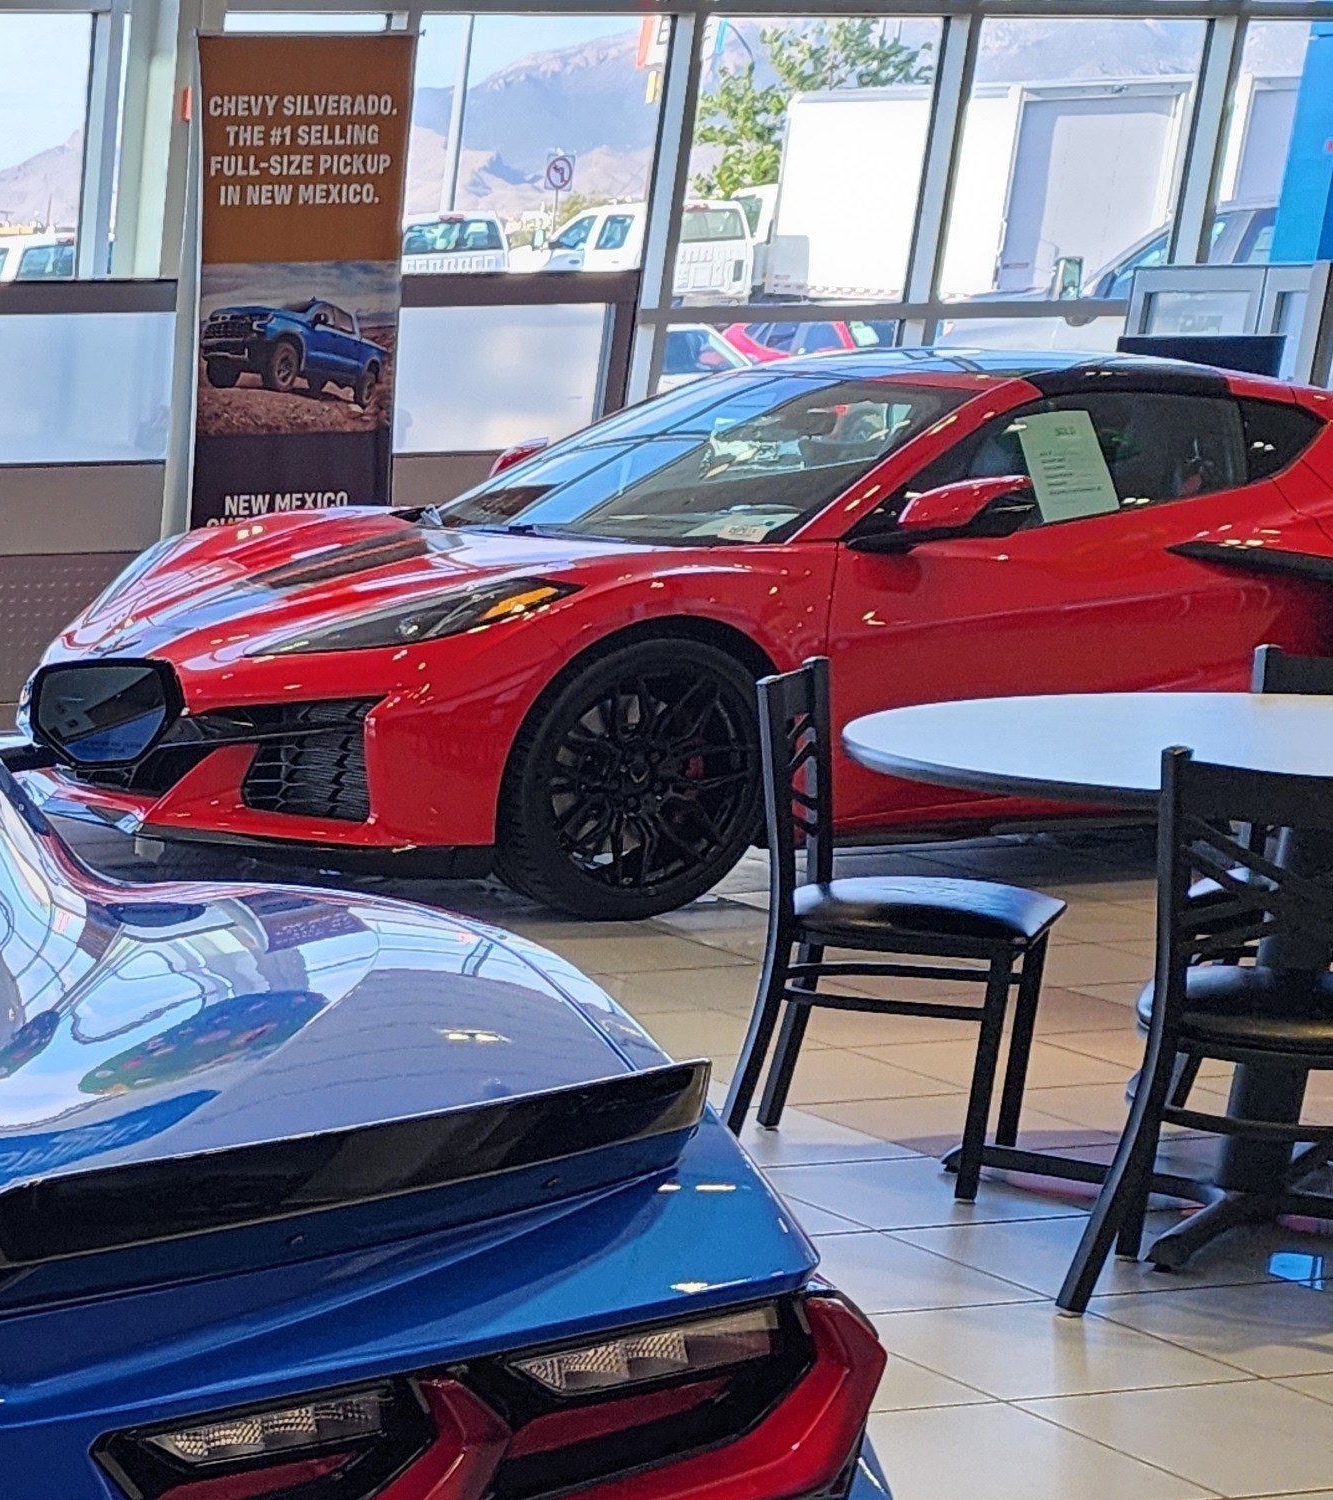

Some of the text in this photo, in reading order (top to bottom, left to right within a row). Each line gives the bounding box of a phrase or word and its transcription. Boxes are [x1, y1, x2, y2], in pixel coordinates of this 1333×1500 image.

[209, 94, 398, 117] CHEVY SILVERADO.
[226, 124, 379, 146] THE #1 SELLING
[210, 154, 391, 177] FULL-SIZE PICKUP
[219, 183, 380, 206] IN NEW MEXICO.
[224, 493, 270, 517] NEW
